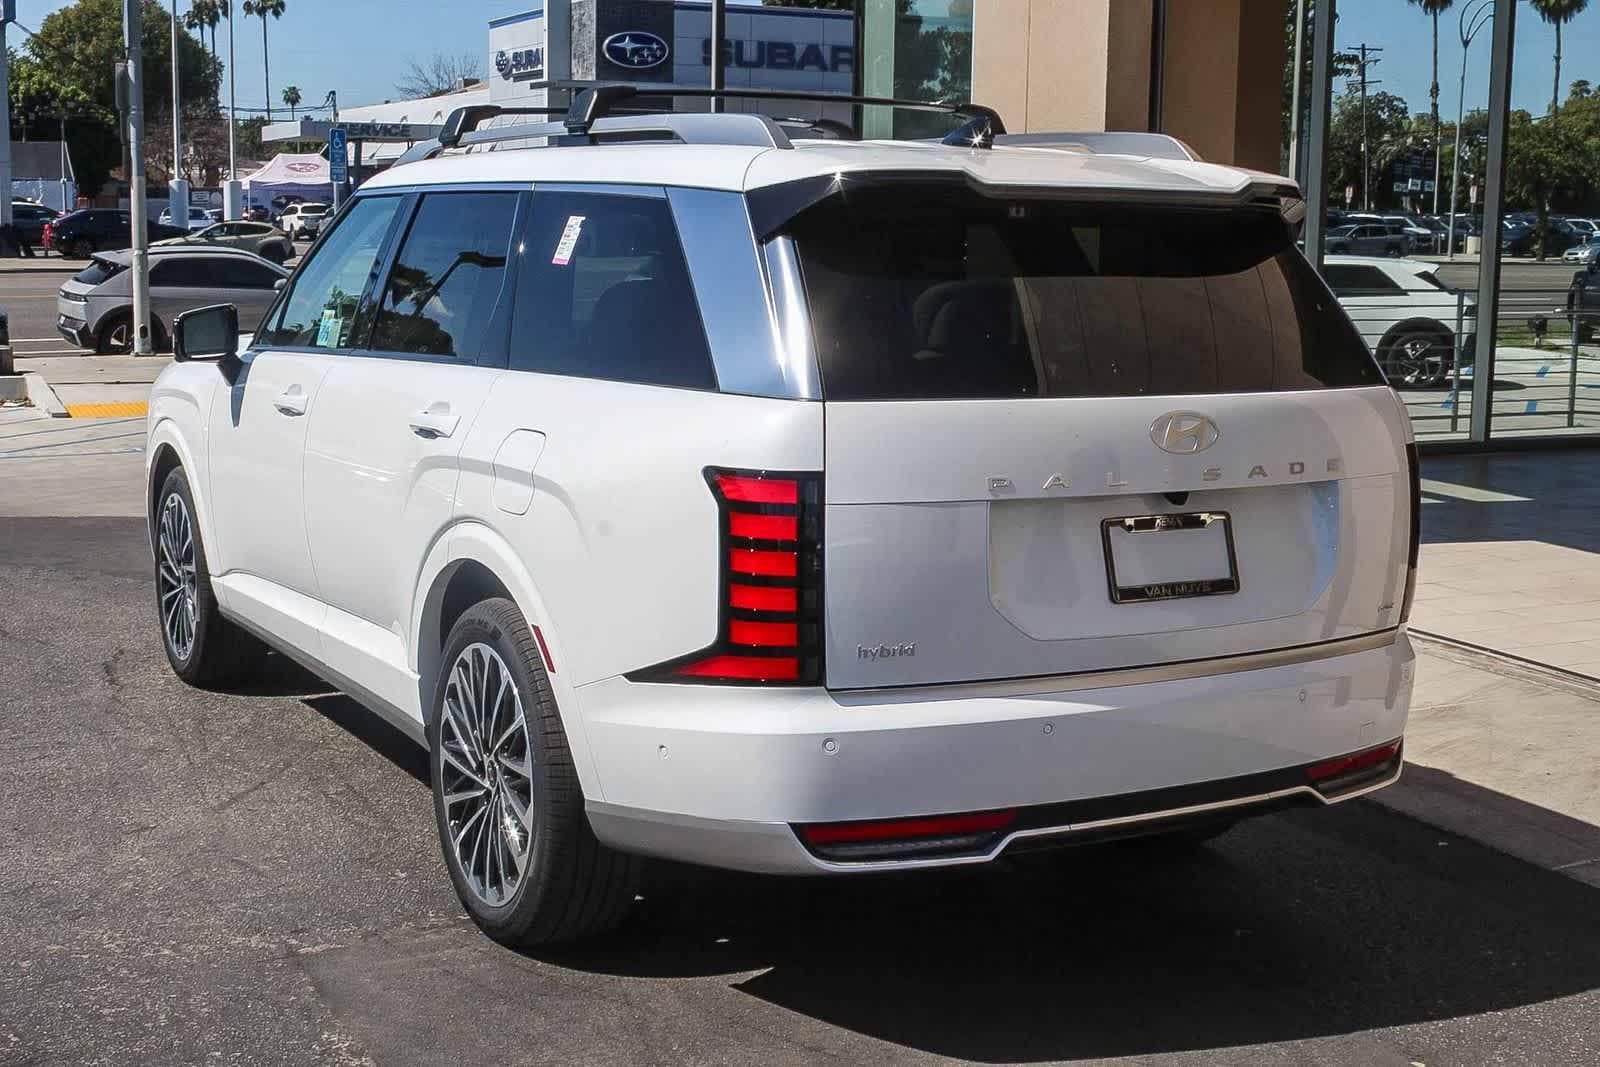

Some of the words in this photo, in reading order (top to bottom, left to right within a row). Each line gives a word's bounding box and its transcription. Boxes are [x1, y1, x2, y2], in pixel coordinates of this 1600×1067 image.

[511, 48, 544, 70] SUBA
[986, 458, 1342, 491] PALISADE
[1144, 582, 1171, 598] VAN
[856, 643, 916, 661] hybrid
